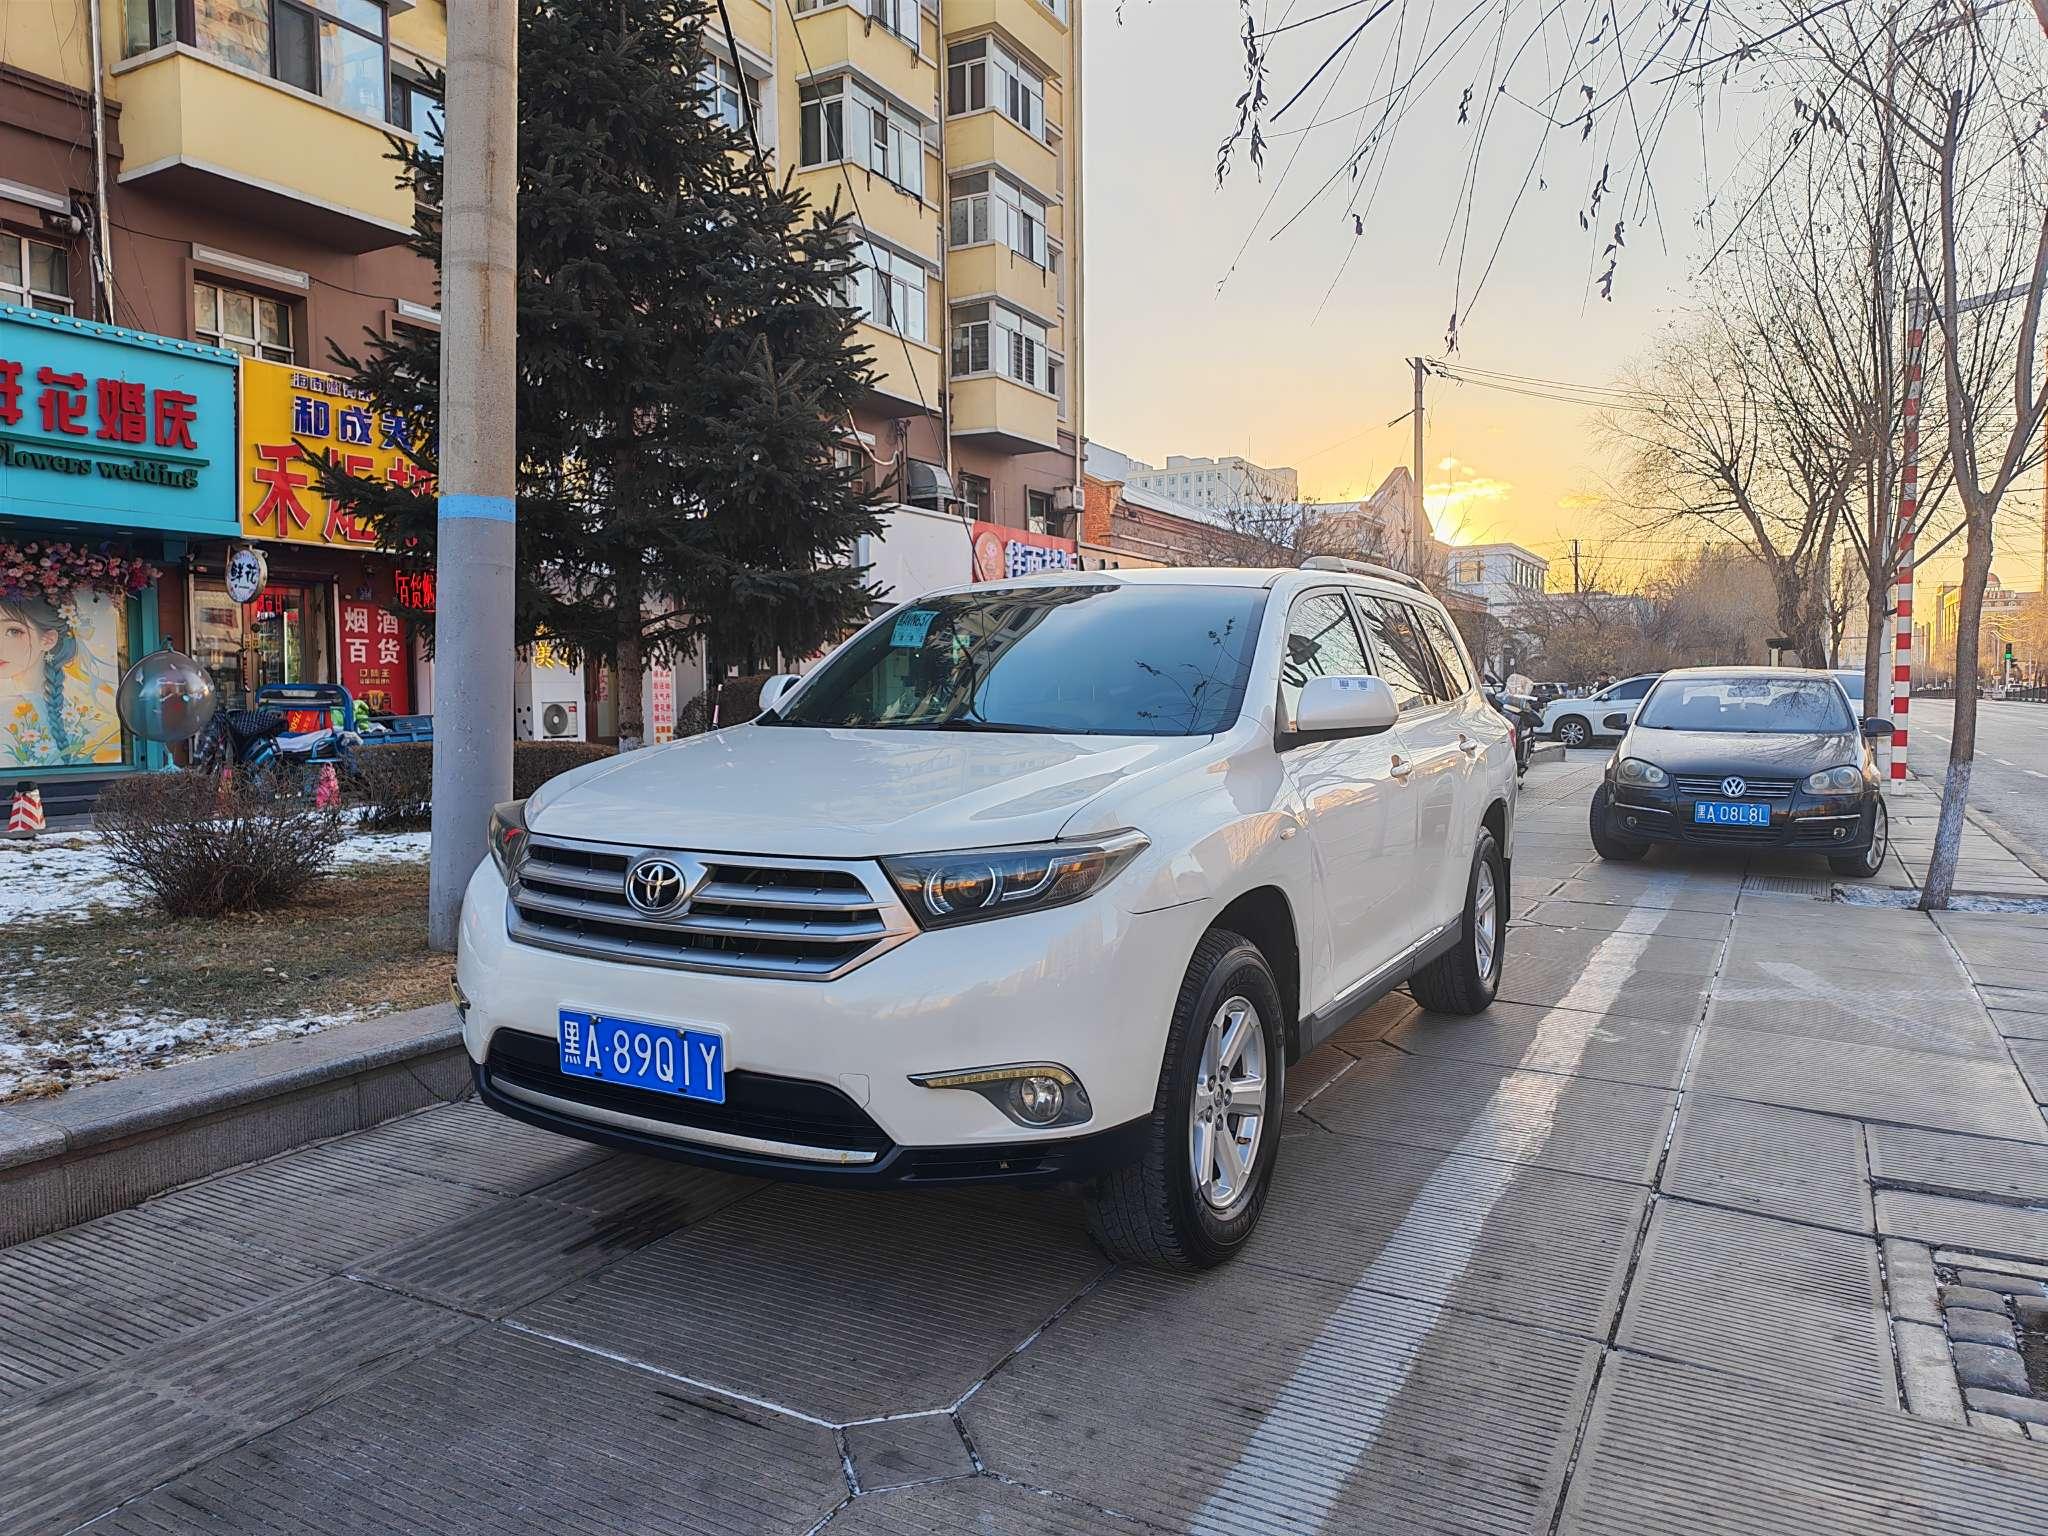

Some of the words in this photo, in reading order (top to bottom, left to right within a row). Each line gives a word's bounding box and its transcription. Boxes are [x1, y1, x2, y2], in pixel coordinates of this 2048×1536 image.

[293, 395, 438, 450] 和成天
[97, 460, 199, 488] wedding
[230, 562, 257, 584] 鲜花
[344, 606, 399, 634] 烟酒
[345, 638, 400, 664] 百货
